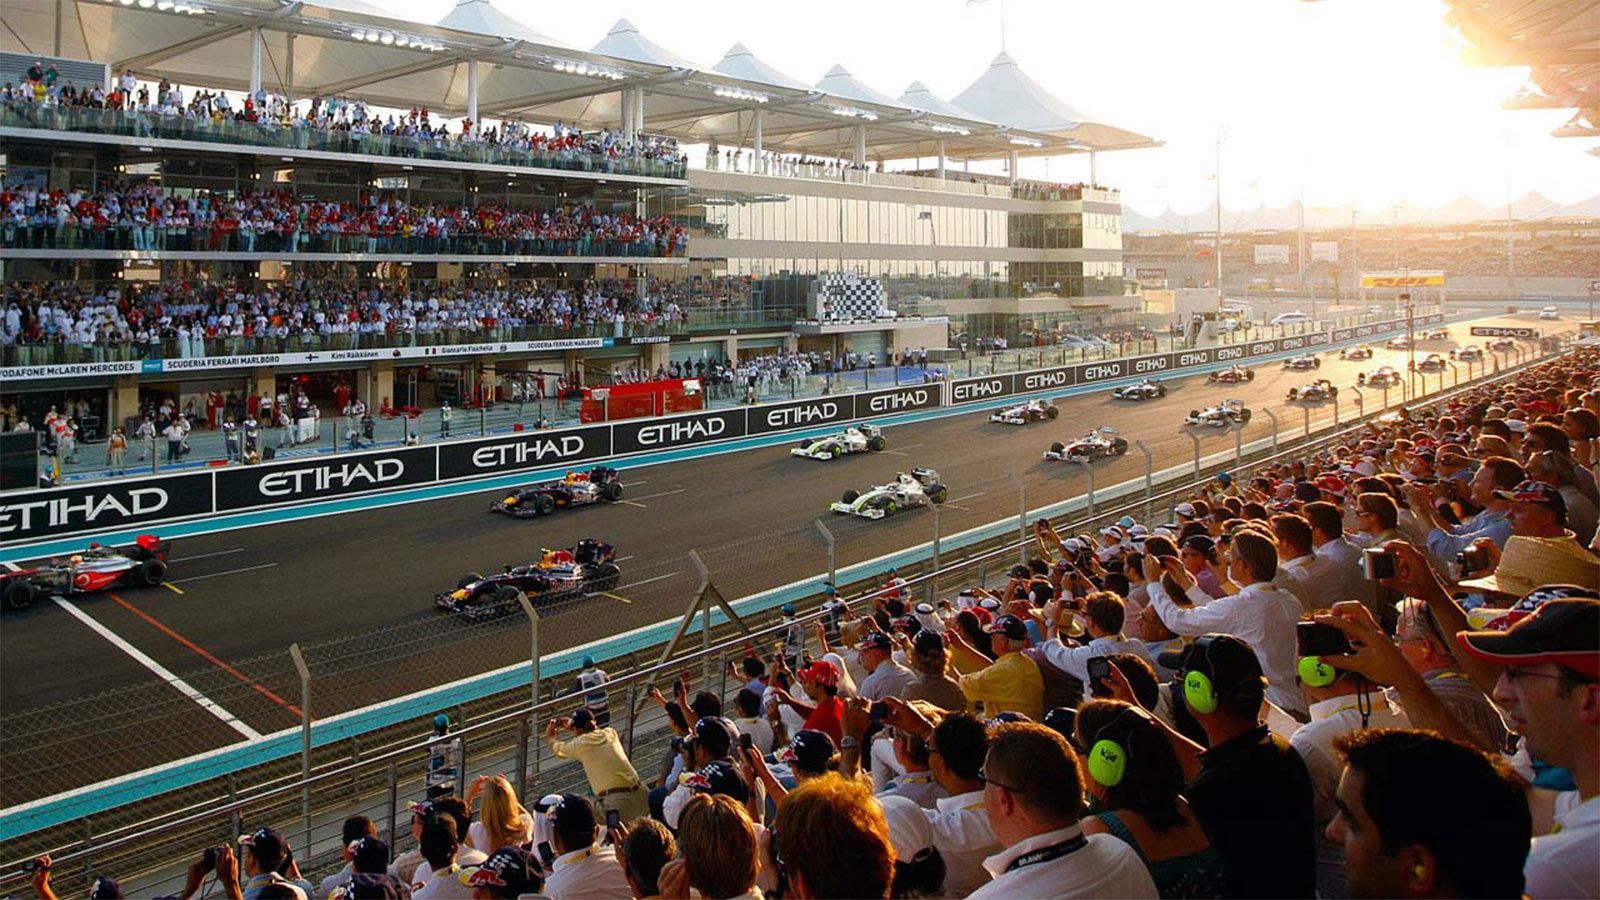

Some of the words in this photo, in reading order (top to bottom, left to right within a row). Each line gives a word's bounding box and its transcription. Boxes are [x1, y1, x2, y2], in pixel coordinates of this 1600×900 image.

[1475, 328, 1530, 337] ETIHAD
[168, 358, 206, 369] SCUDERIA
[208, 357, 239, 366] FERRARI
[241, 355, 280, 364] MARLBORO
[1180, 352, 1208, 366] ETIHAD
[1218, 347, 1243, 360] ETIHAD
[0, 367, 45, 378] ODAFONE
[47, 364, 88, 375] McLAREN
[90, 363, 135, 373] MERCEDES
[1085, 364, 1121, 380] ETIHAD
[1135, 357, 1168, 373] ETIHAD
[1024, 371, 1067, 389] ETIHAD
[954, 380, 1003, 399] ETIHAD
[869, 390, 928, 412] ETIHAD
[767, 402, 838, 427] ETIHAD
[637, 417, 726, 446] ETIHAD
[472, 435, 585, 468] ETIHAD
[258, 458, 405, 497] ETIHAD
